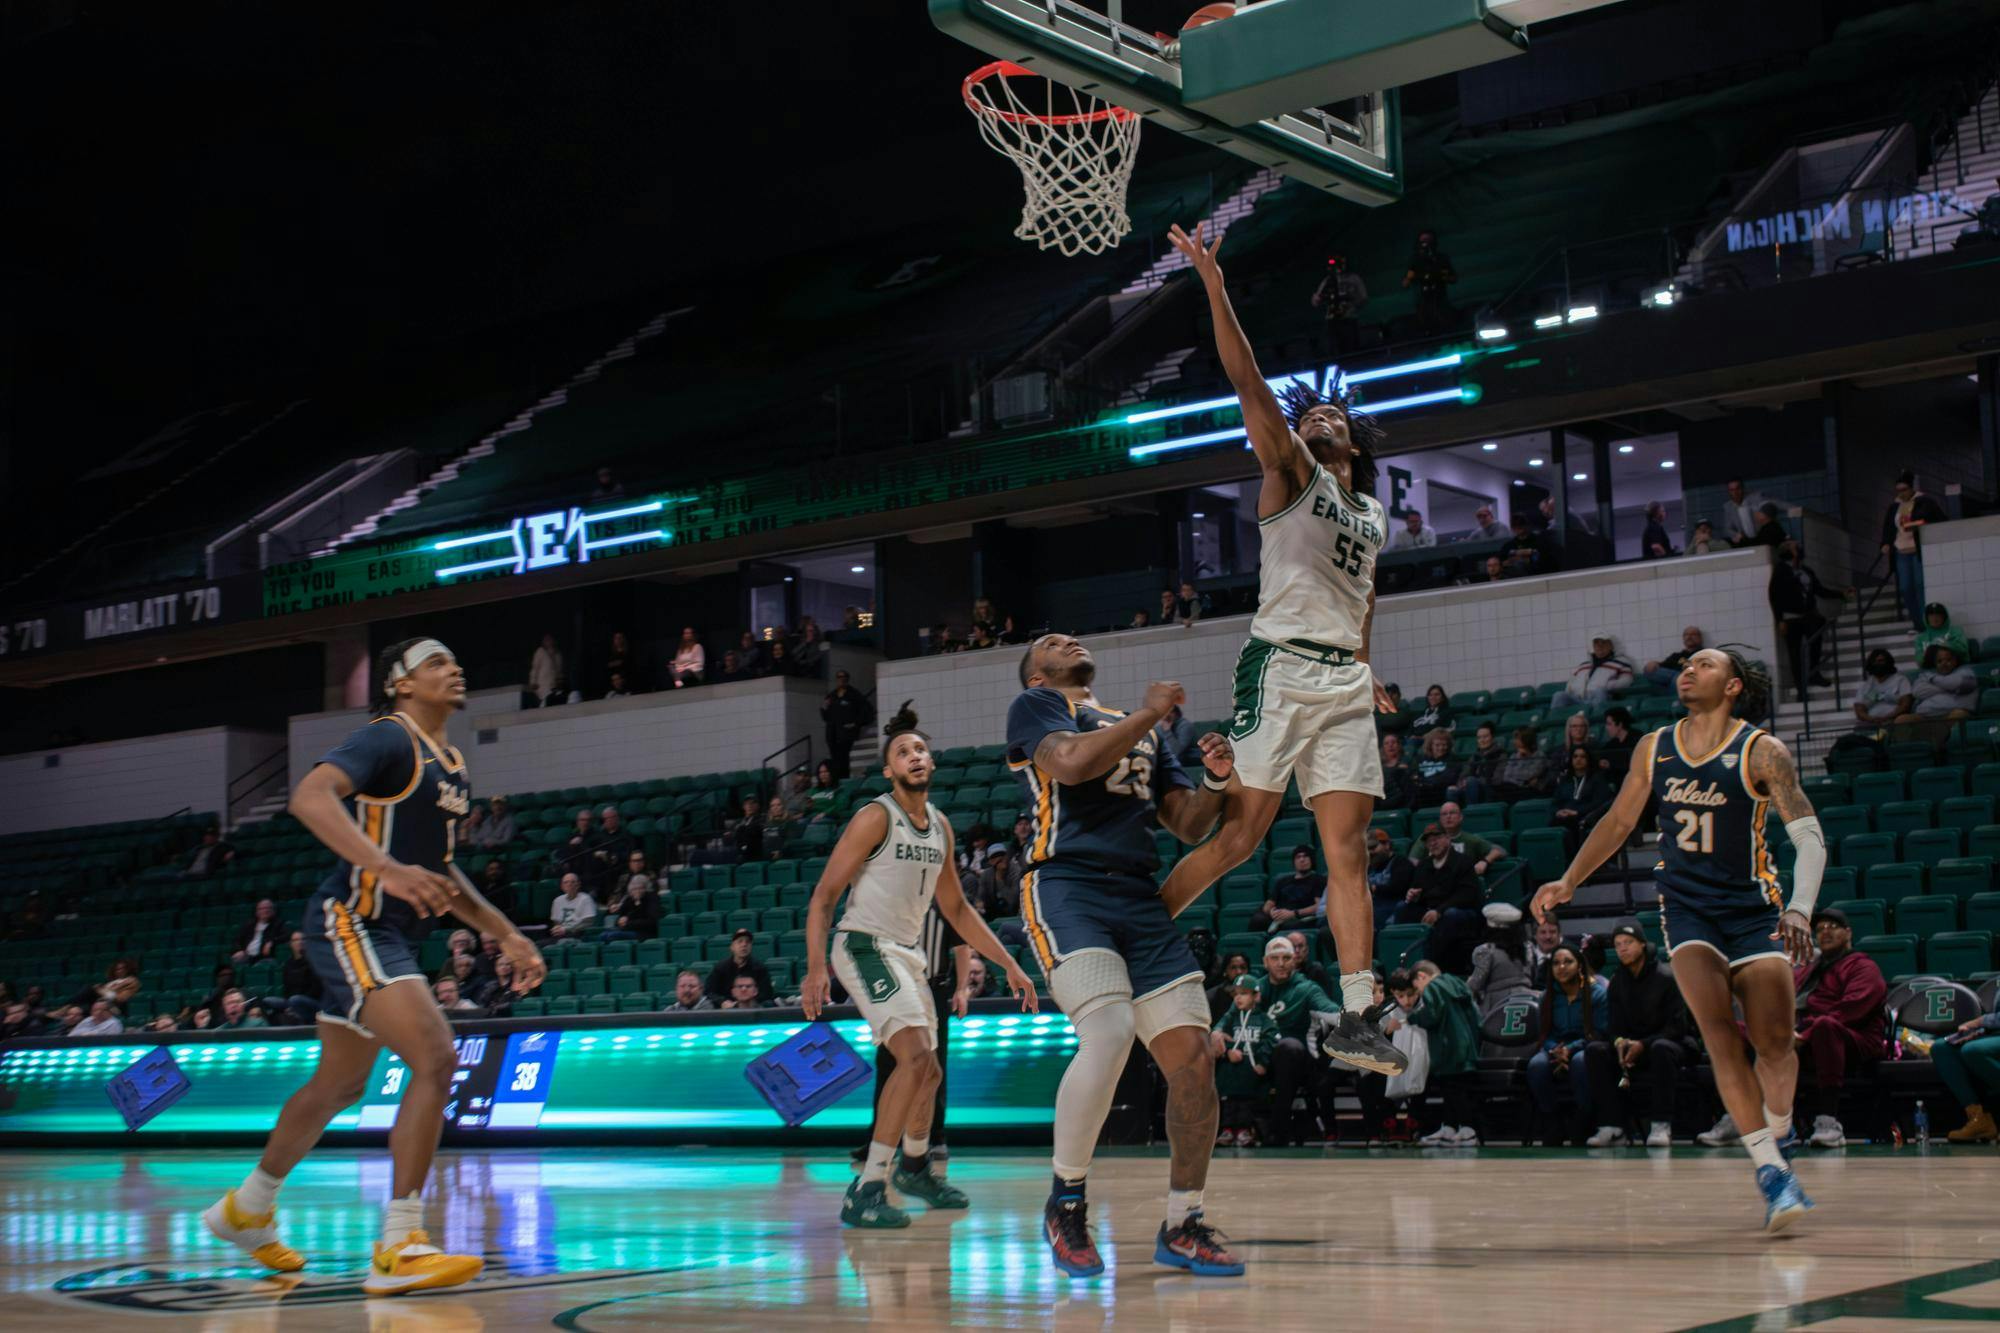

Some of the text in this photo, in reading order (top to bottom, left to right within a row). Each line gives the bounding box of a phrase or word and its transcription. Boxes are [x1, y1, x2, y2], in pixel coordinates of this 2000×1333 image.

[1387, 465, 1412, 519] E
[1312, 496, 1383, 546] EASTER
[1332, 533, 1366, 577] 55
[84, 586, 220, 640] MARLATT '70
[1104, 755, 1152, 801] 23
[1662, 777, 1728, 807] Toledo
[1673, 809, 1713, 854] 21
[920, 868, 927, 896] 1
[1501, 1005, 1528, 1036] E
[1924, 988, 1955, 1022] E
[381, 1061, 541, 1095] 31 38
